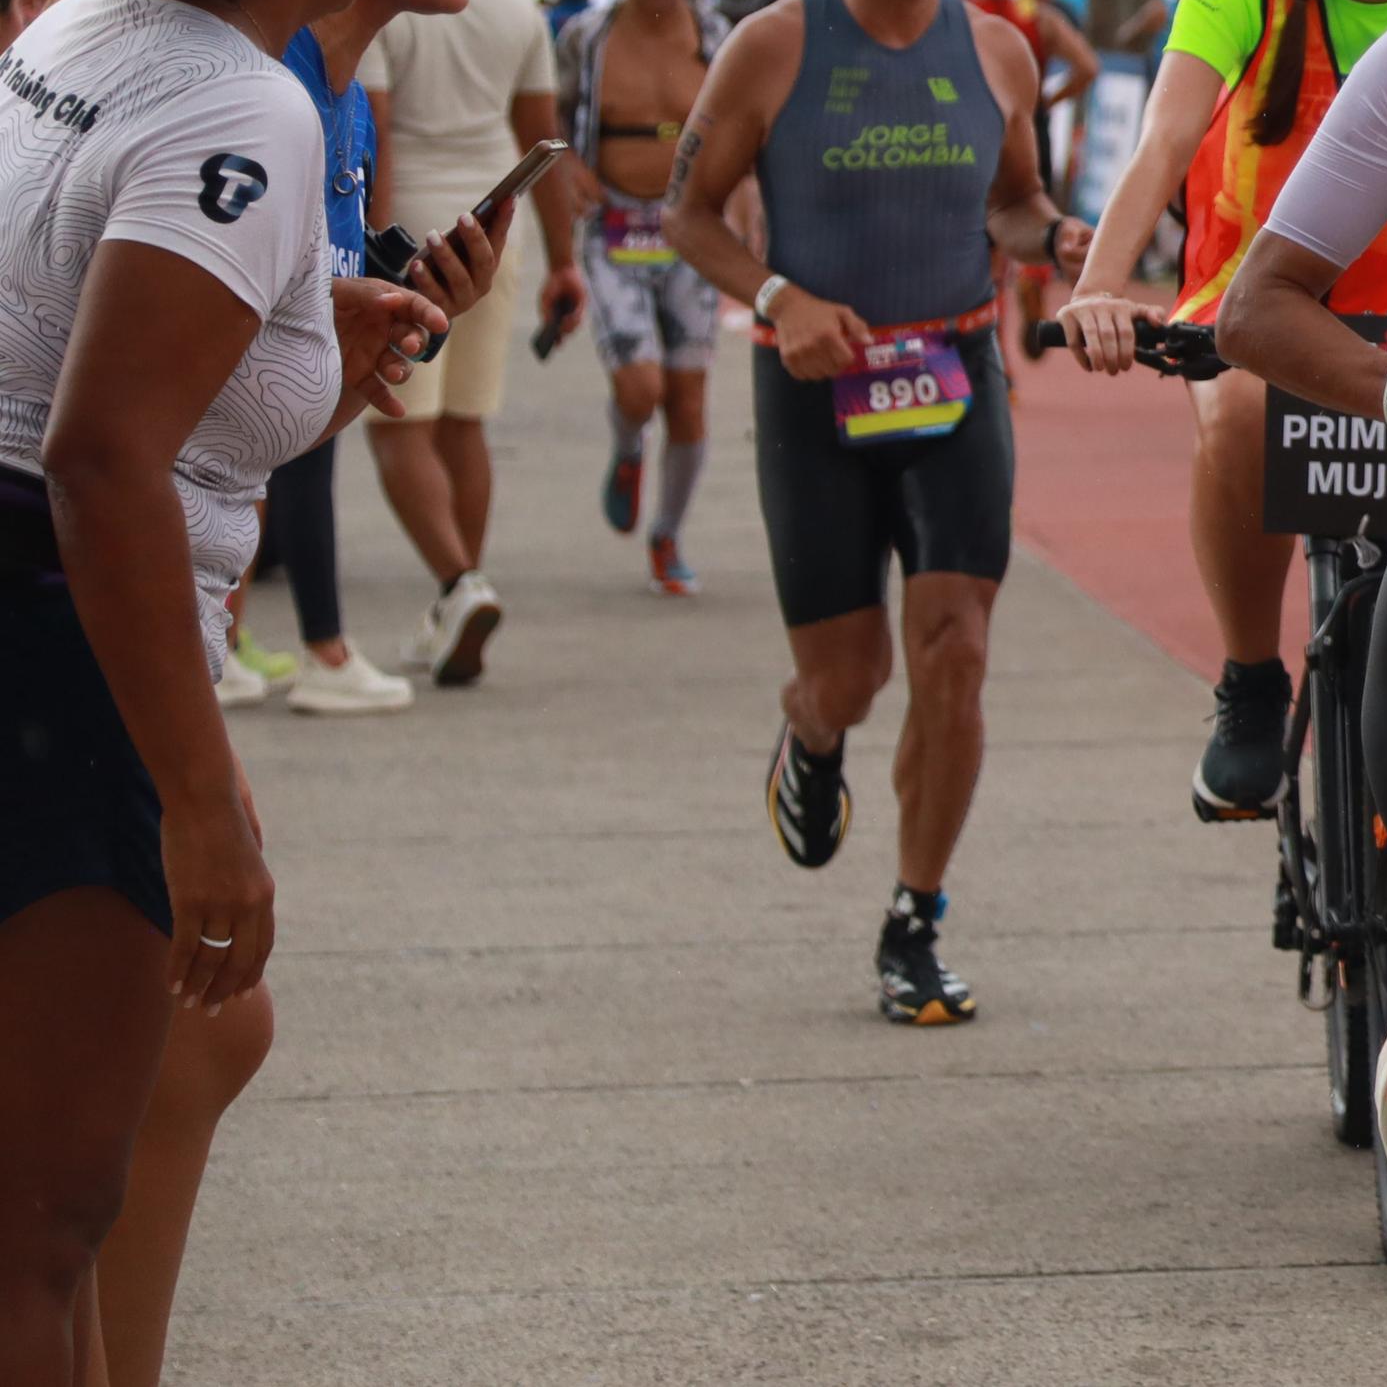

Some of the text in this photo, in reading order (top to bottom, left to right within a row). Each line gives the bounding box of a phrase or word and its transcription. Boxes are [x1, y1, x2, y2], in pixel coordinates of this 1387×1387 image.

[3, 57, 57, 119] Training
[53, 93, 101, 134] Club
[851, 123, 947, 147] JORGE
[822, 143, 976, 170] COLOMBIA
[868, 372, 939, 412] 890
